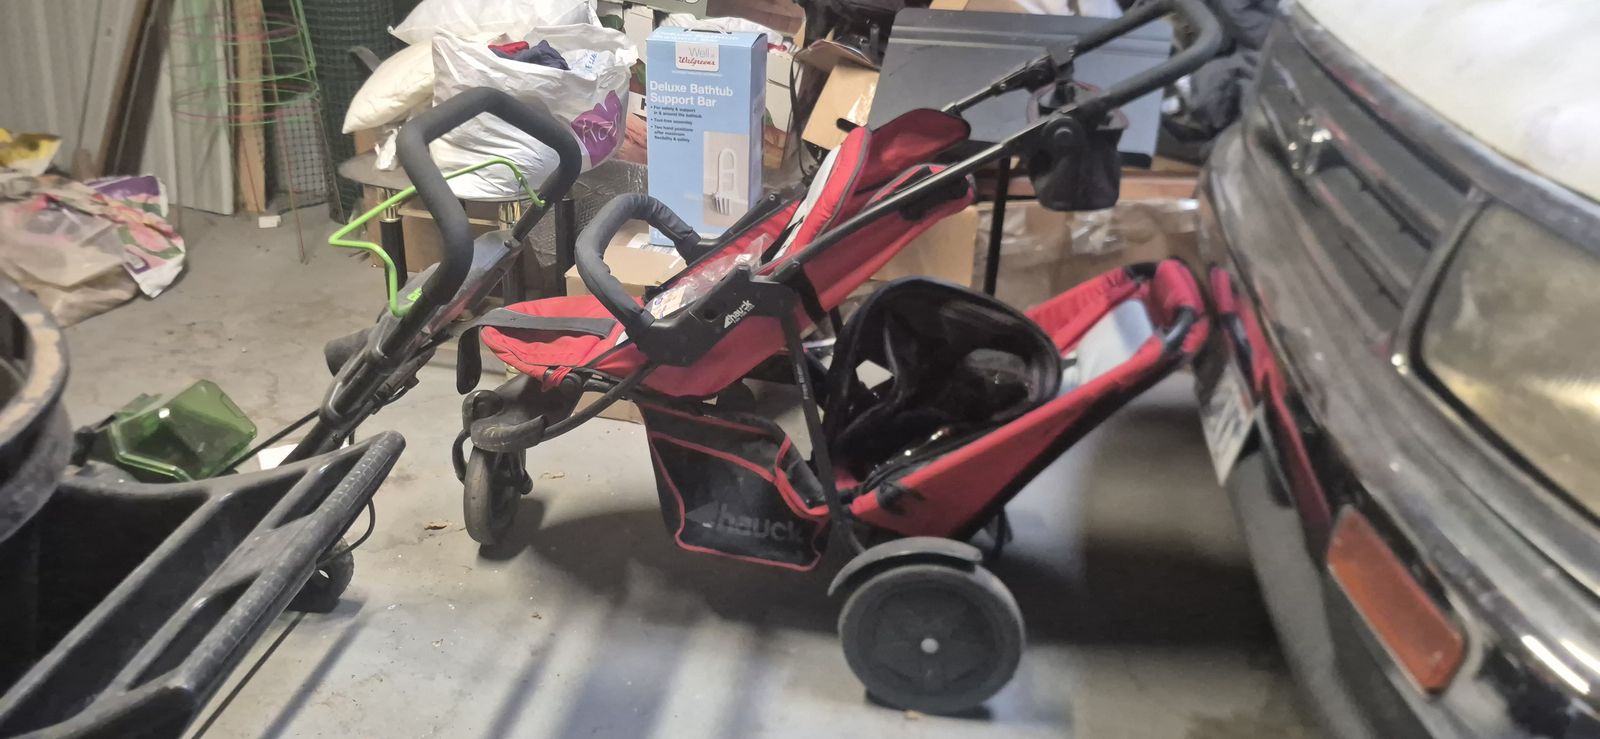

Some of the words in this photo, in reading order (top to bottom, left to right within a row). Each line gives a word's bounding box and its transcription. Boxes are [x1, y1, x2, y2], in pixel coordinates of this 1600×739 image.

[688, 47, 709, 58] Well
[678, 56, 716, 67] Walgreens
[650, 80, 687, 92] Deluxe
[690, 84, 734, 96] Bathtub
[650, 92, 694, 106] Support
[697, 96, 718, 107] Bar
[726, 299, 753, 323] hauck
